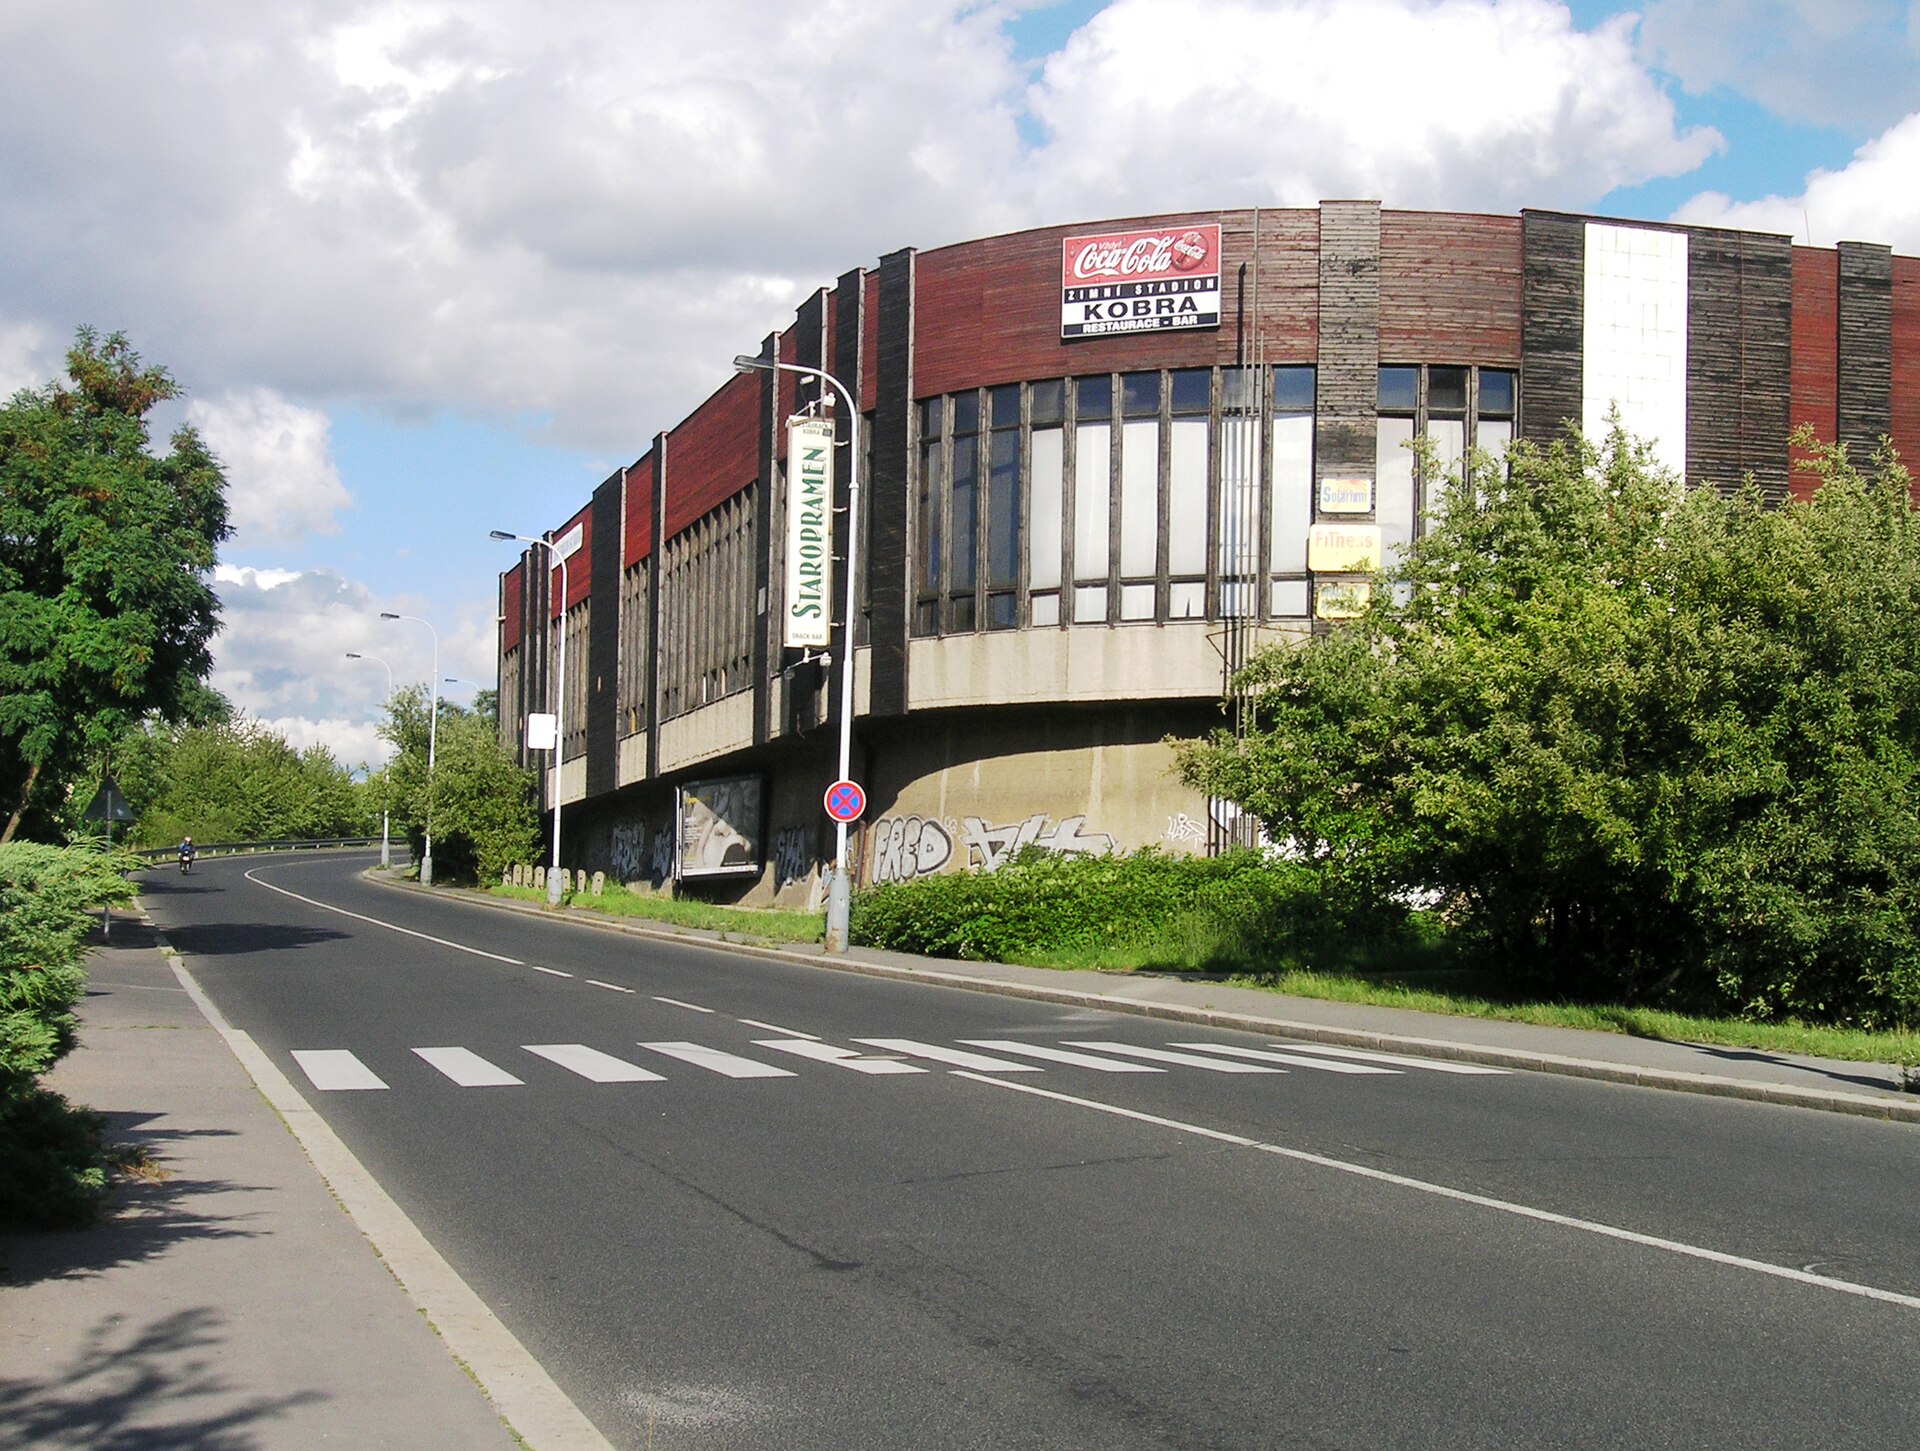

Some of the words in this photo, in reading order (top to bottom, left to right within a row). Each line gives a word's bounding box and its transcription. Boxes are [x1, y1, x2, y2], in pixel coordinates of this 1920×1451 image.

[1074, 235, 1177, 279] Coca-Cola
[1067, 284, 1121, 301] ZIMNÍ
[1135, 278, 1215, 295] STADION
[1084, 295, 1199, 321] KOBRA
[1082, 317, 1160, 333] RESTAURACE
[1172, 315, 1198, 327] BAR
[1322, 486, 1367, 503] Solarium
[791, 446, 827, 619] STAROPRAMEN
